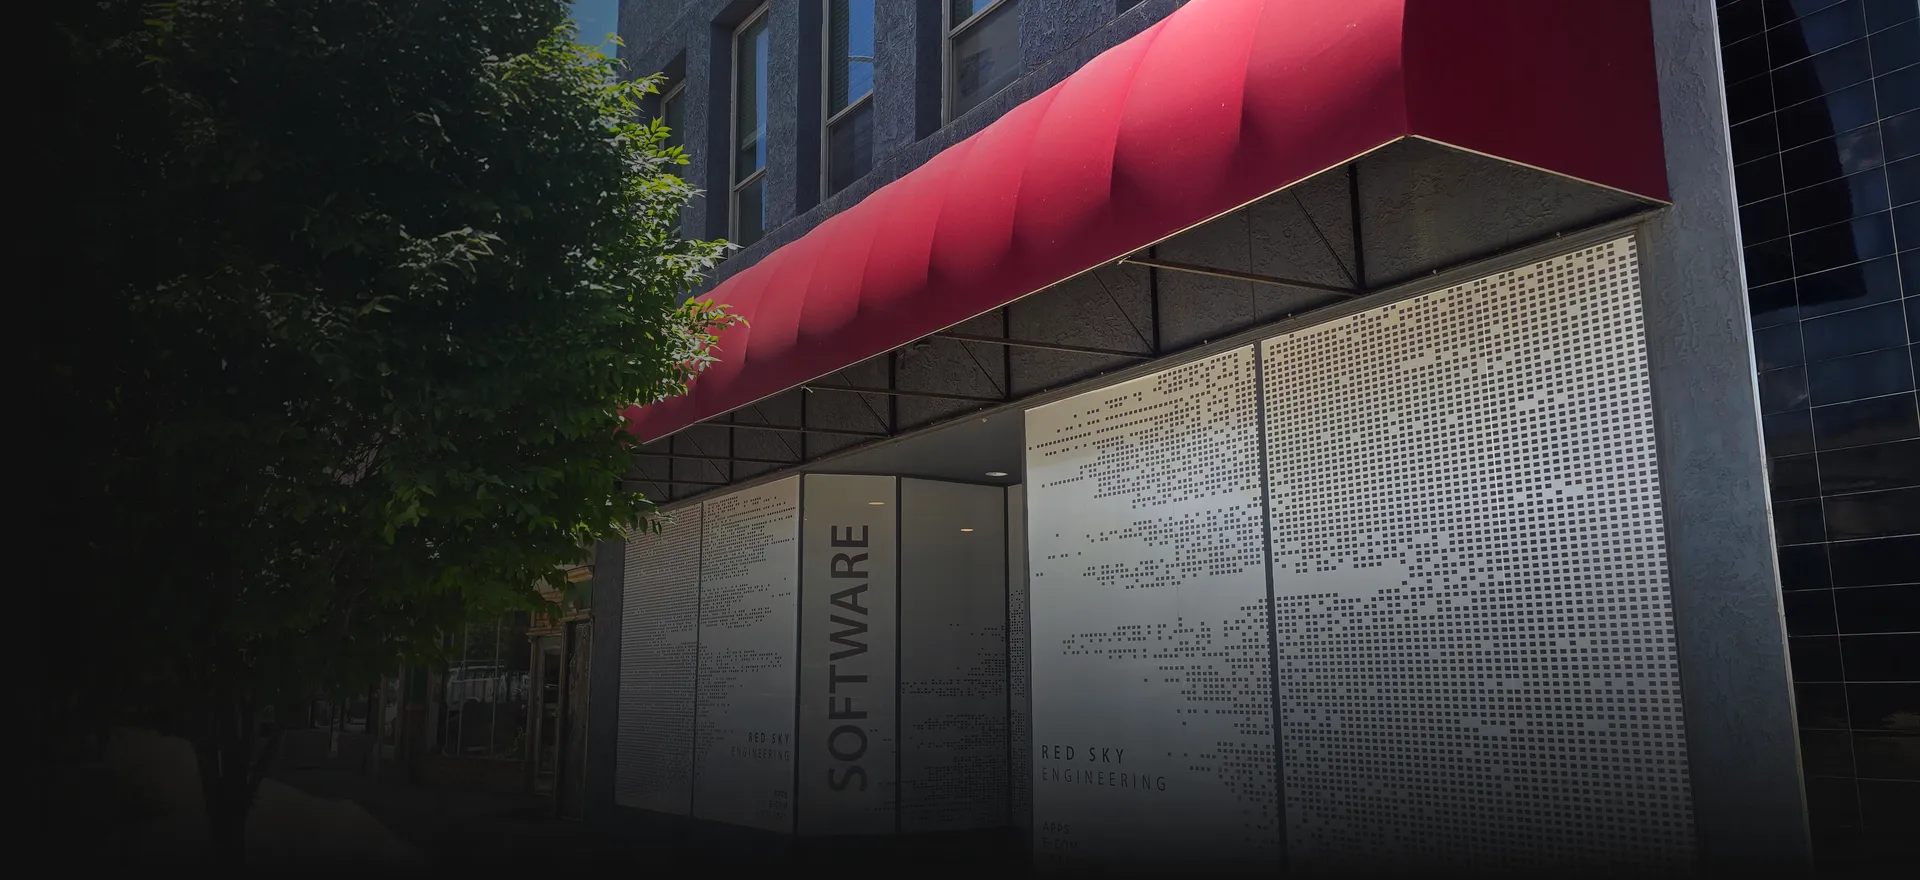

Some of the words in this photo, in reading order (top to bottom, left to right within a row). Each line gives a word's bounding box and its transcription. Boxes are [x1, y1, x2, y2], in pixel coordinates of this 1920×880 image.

[828, 525, 868, 791] SOFTWARE
[748, 732, 766, 743] RED
[772, 733, 790, 745] SKY
[731, 746, 790, 761] ENGINEERING
[1042, 745, 1075, 760] RED
[1089, 747, 1124, 763] SKY
[1042, 766, 1166, 791] ENGINEERING
[1042, 822, 1070, 835] APPS
